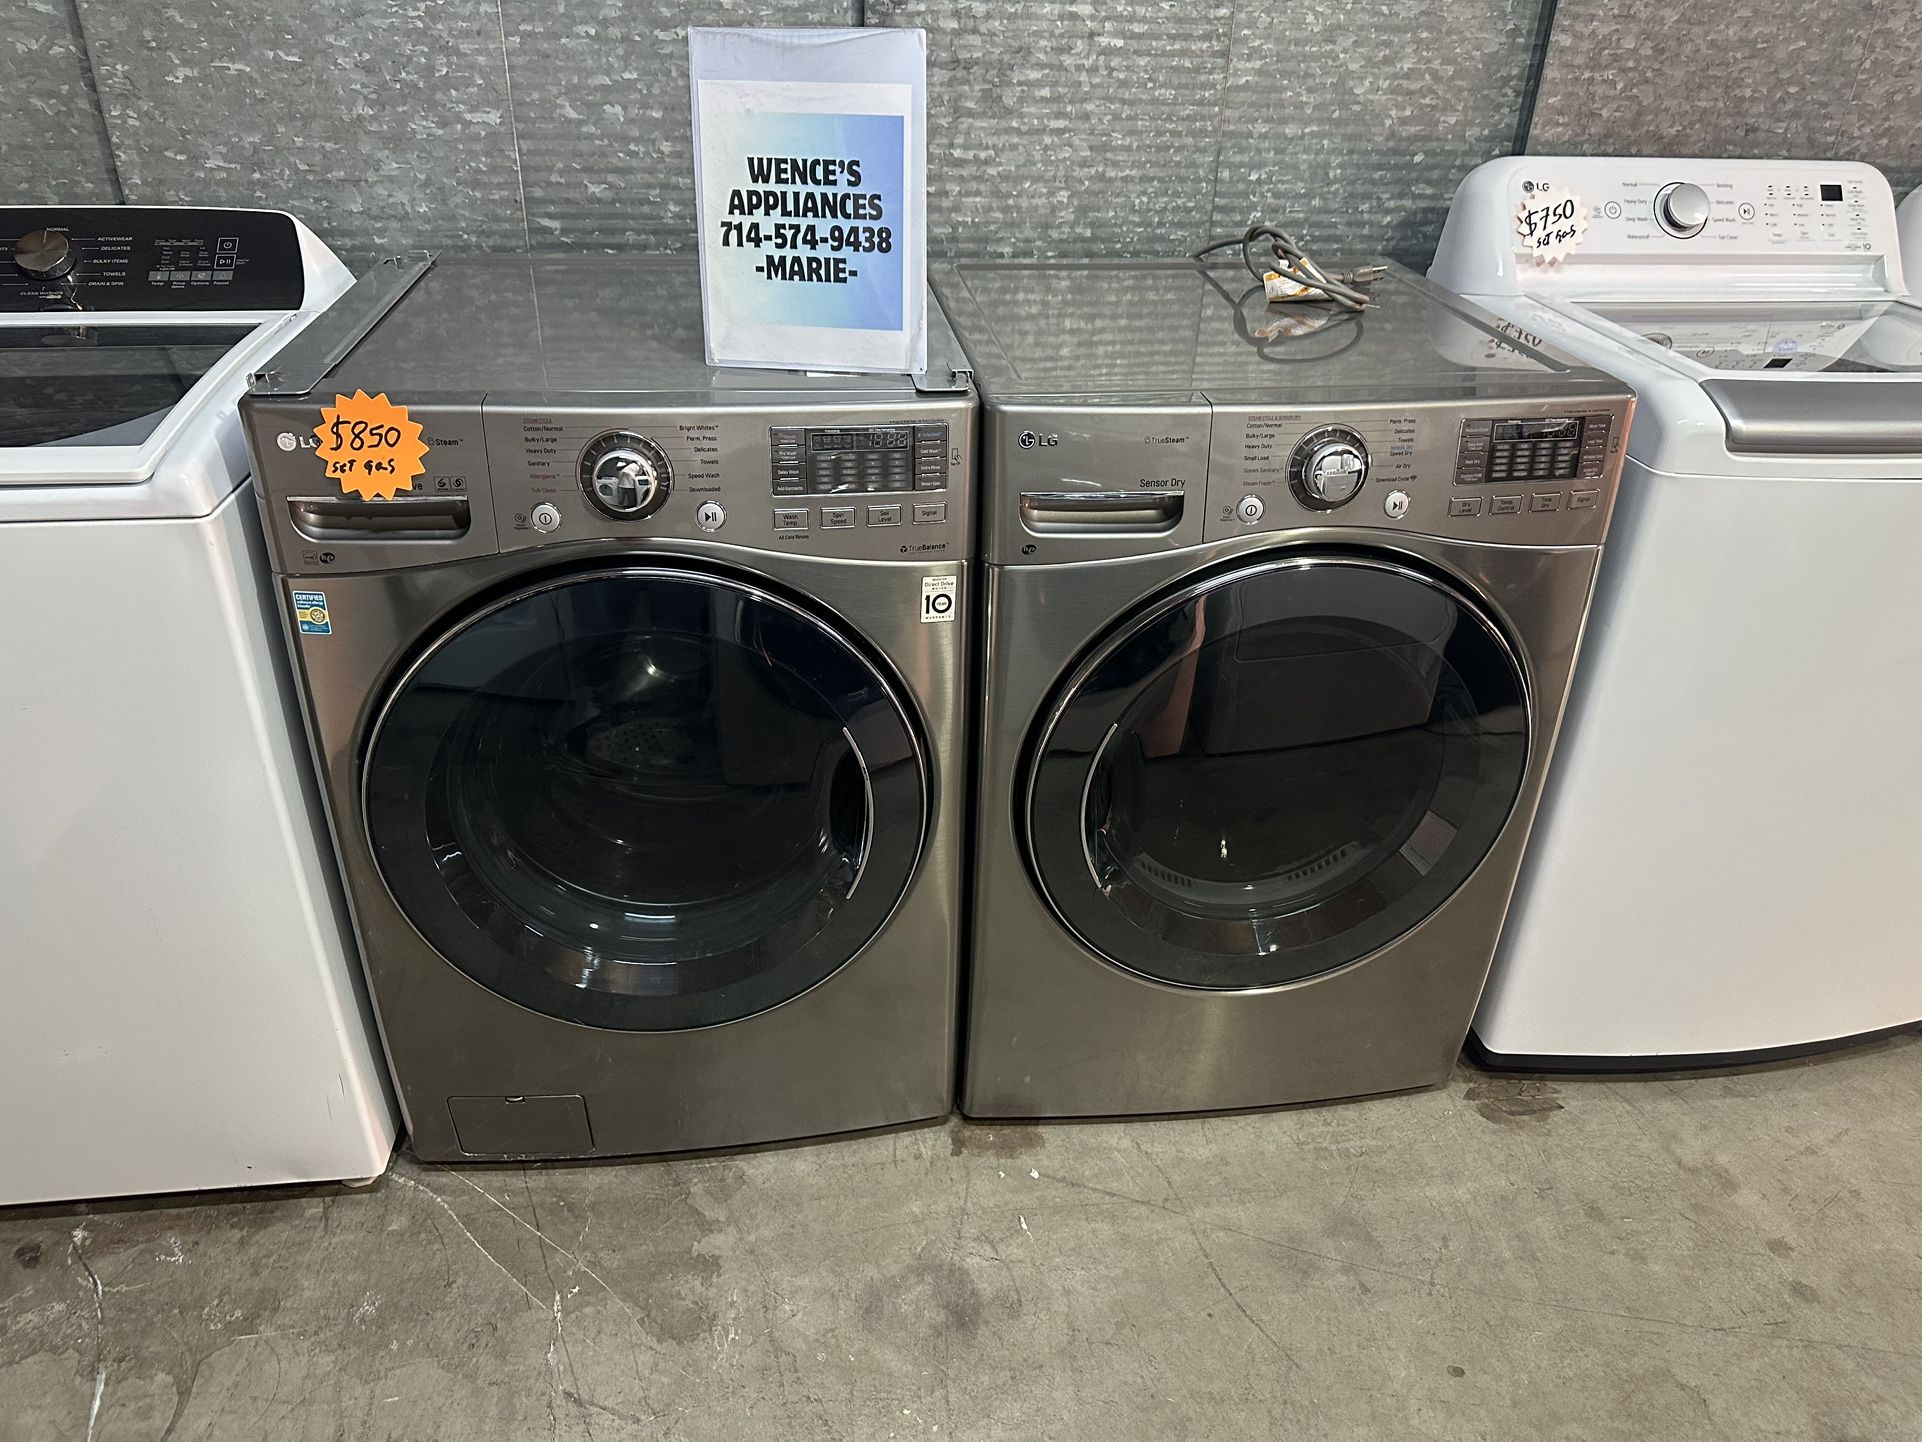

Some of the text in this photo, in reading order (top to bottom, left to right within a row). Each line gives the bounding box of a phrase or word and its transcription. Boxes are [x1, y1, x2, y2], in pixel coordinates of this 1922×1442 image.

[747, 156, 861, 187] WENCE'S
[1536, 182, 1550, 192] LG
[727, 189, 883, 221] APPLIANCES
[1524, 199, 1575, 237] $750
[720, 221, 892, 254] 714-574-9438
[755, 254, 858, 284] -MARIE-
[330, 414, 401, 451] $850
[1038, 433, 1058, 446] LG
[332, 458, 396, 476] set gas
[1140, 478, 1186, 488] Sensor Dry
[925, 593, 952, 614] 10
